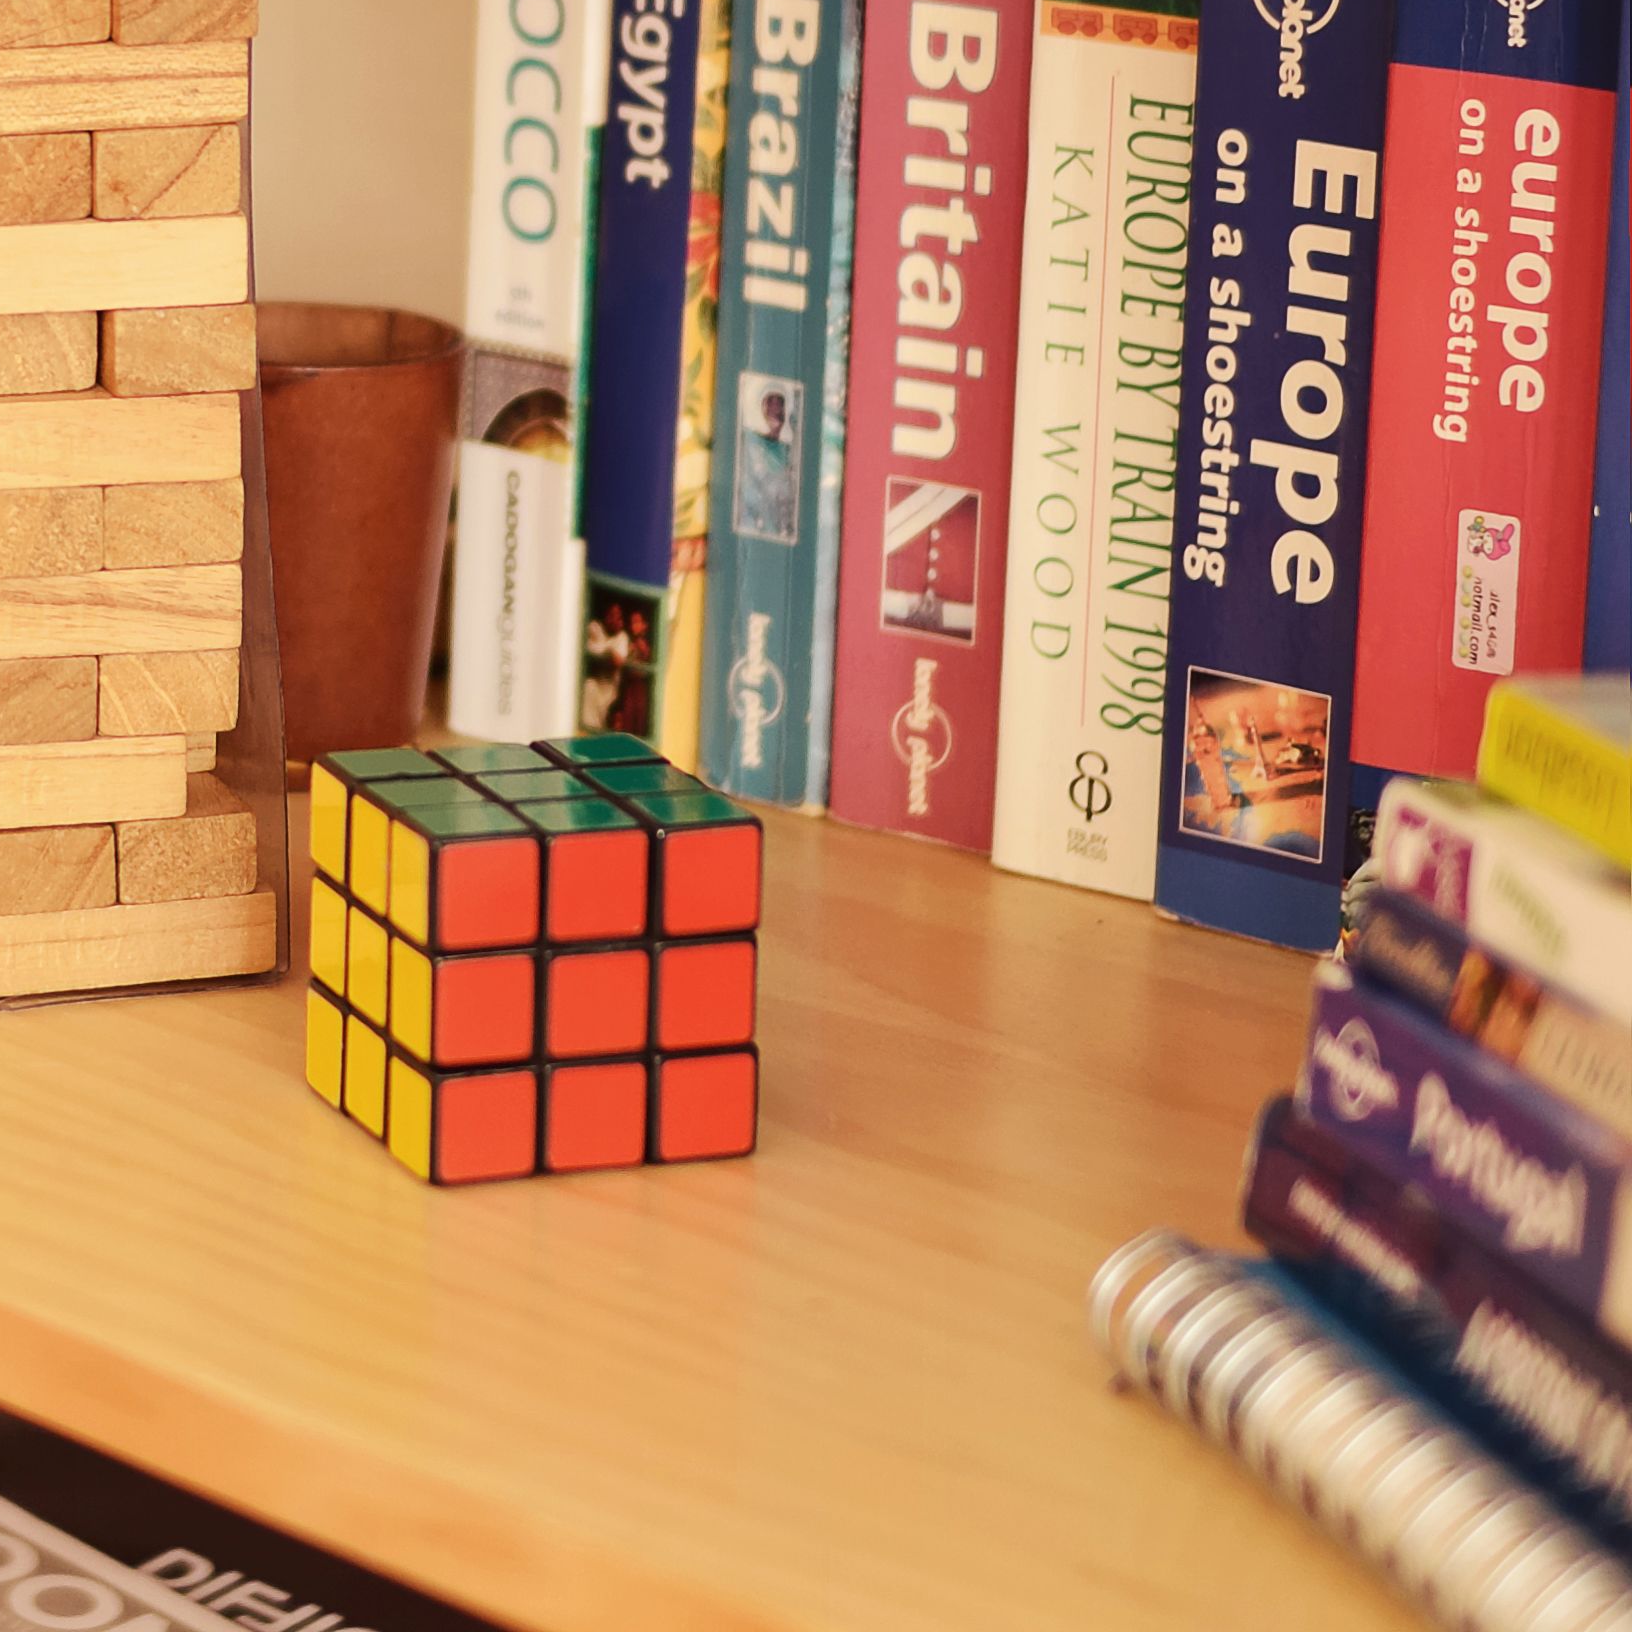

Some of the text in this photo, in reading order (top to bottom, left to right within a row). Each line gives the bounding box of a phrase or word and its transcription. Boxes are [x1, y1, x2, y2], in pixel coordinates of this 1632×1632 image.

[1030, 143, 1095, 660] KATIE WOOD
[1099, 93, 1194, 737] EUROPE BY TRAIN 1998
[1183, 127, 1251, 588] on a shoestring
[1249, 138, 1378, 605] Europe
[1432, 97, 1489, 443] on a shoestring
[1486, 107, 1562, 414] europe
